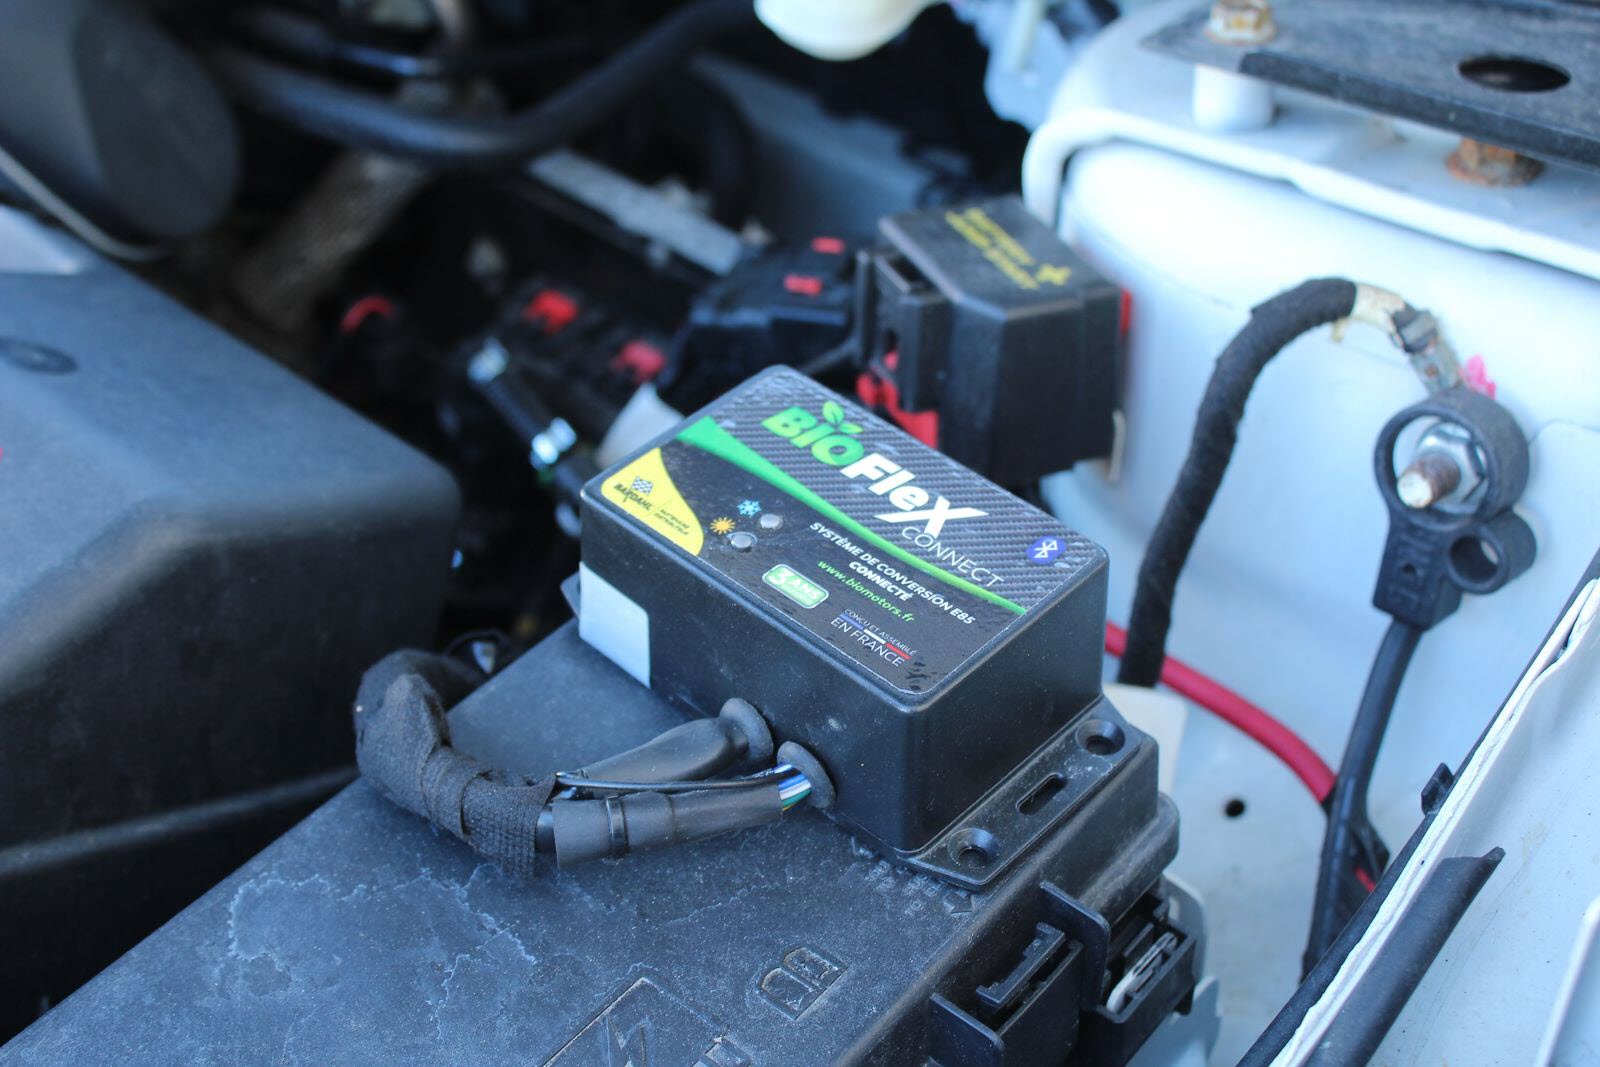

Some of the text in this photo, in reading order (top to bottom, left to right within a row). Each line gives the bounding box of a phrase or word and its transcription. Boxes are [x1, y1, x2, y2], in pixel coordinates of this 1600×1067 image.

[810, 522, 976, 625] SYSTÈME DE CONVERSION E85
[849, 561, 914, 601] CONNECTÉ
[902, 526, 1004, 588] CONNECT
[818, 560, 915, 622] www.biomotors.fr
[830, 617, 905, 667] EN FRANCE
[869, 625, 880, 633] ET
